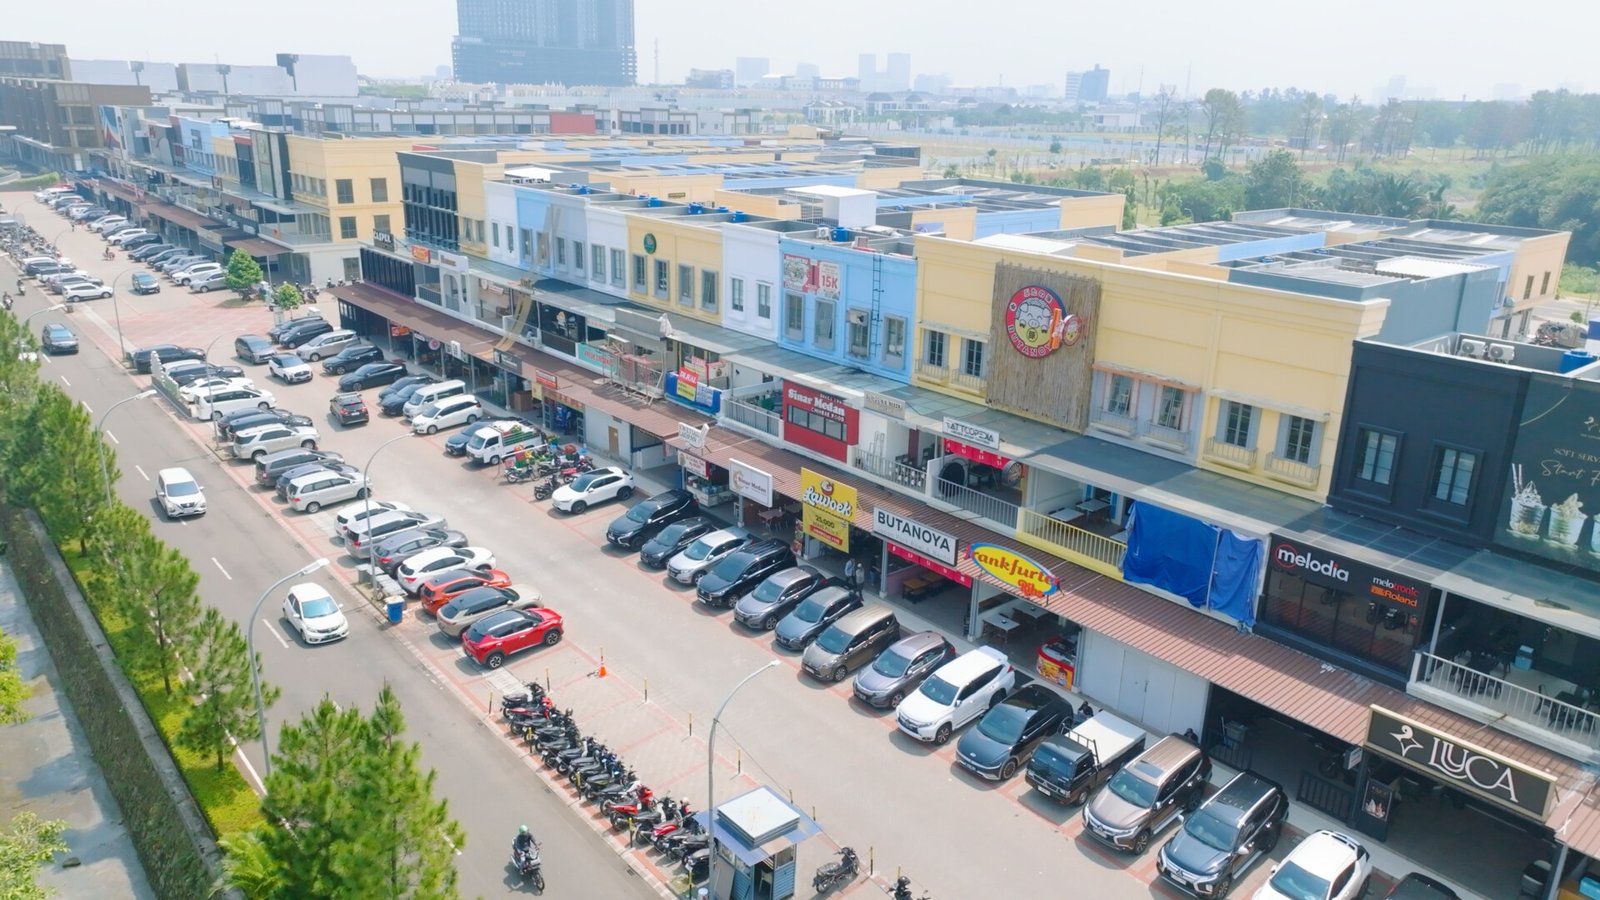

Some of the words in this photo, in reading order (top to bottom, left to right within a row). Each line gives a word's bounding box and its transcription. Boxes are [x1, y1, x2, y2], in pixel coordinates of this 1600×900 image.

[822, 275, 838, 289] 15K
[1008, 325, 1053, 357] BUTANOY
[788, 389, 813, 405] Sinar
[814, 397, 845, 417] Medan
[1541, 459, 1585, 480] Start
[1553, 448, 1575, 459] SOFT
[1578, 453, 1600, 463] SERV
[878, 511, 951, 553] BUTANOYA
[1278, 548, 1350, 582] melodia
[1385, 589, 1418, 607] Roland
[1428, 737, 1518, 803] LUCA
